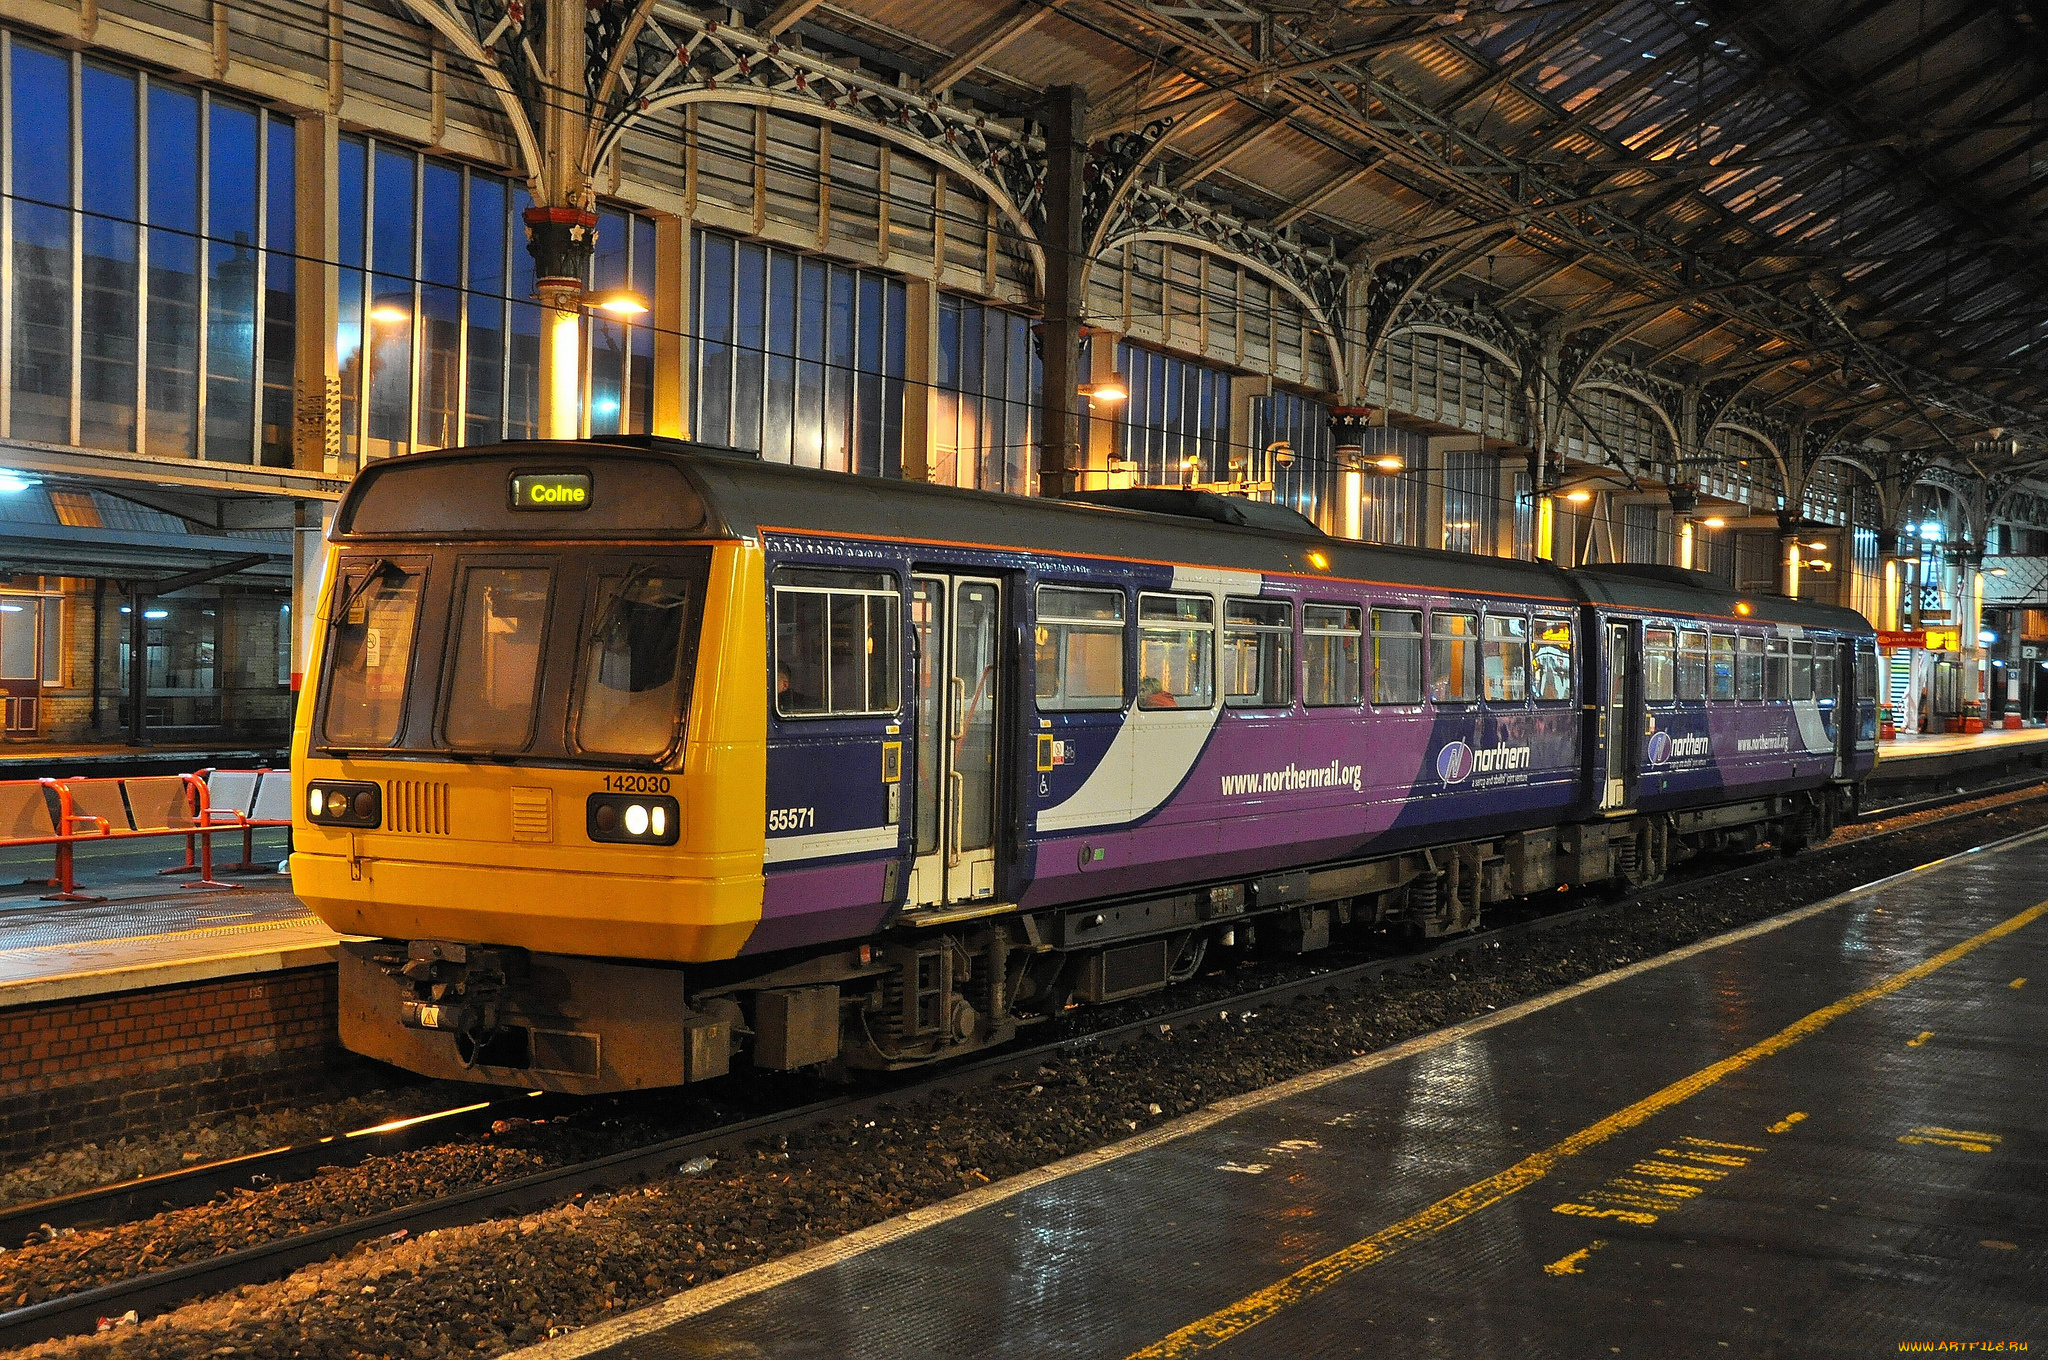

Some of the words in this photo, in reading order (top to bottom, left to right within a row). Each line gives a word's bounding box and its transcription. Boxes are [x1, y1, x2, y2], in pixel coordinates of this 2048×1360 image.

[531, 485, 585, 502] Colne
[1671, 732, 1709, 756] northern
[1473, 742, 1530, 772] northern
[602, 775, 671, 793] 142030
[1221, 759, 1362, 795] www.northernrail.org
[768, 807, 815, 831] 55571
